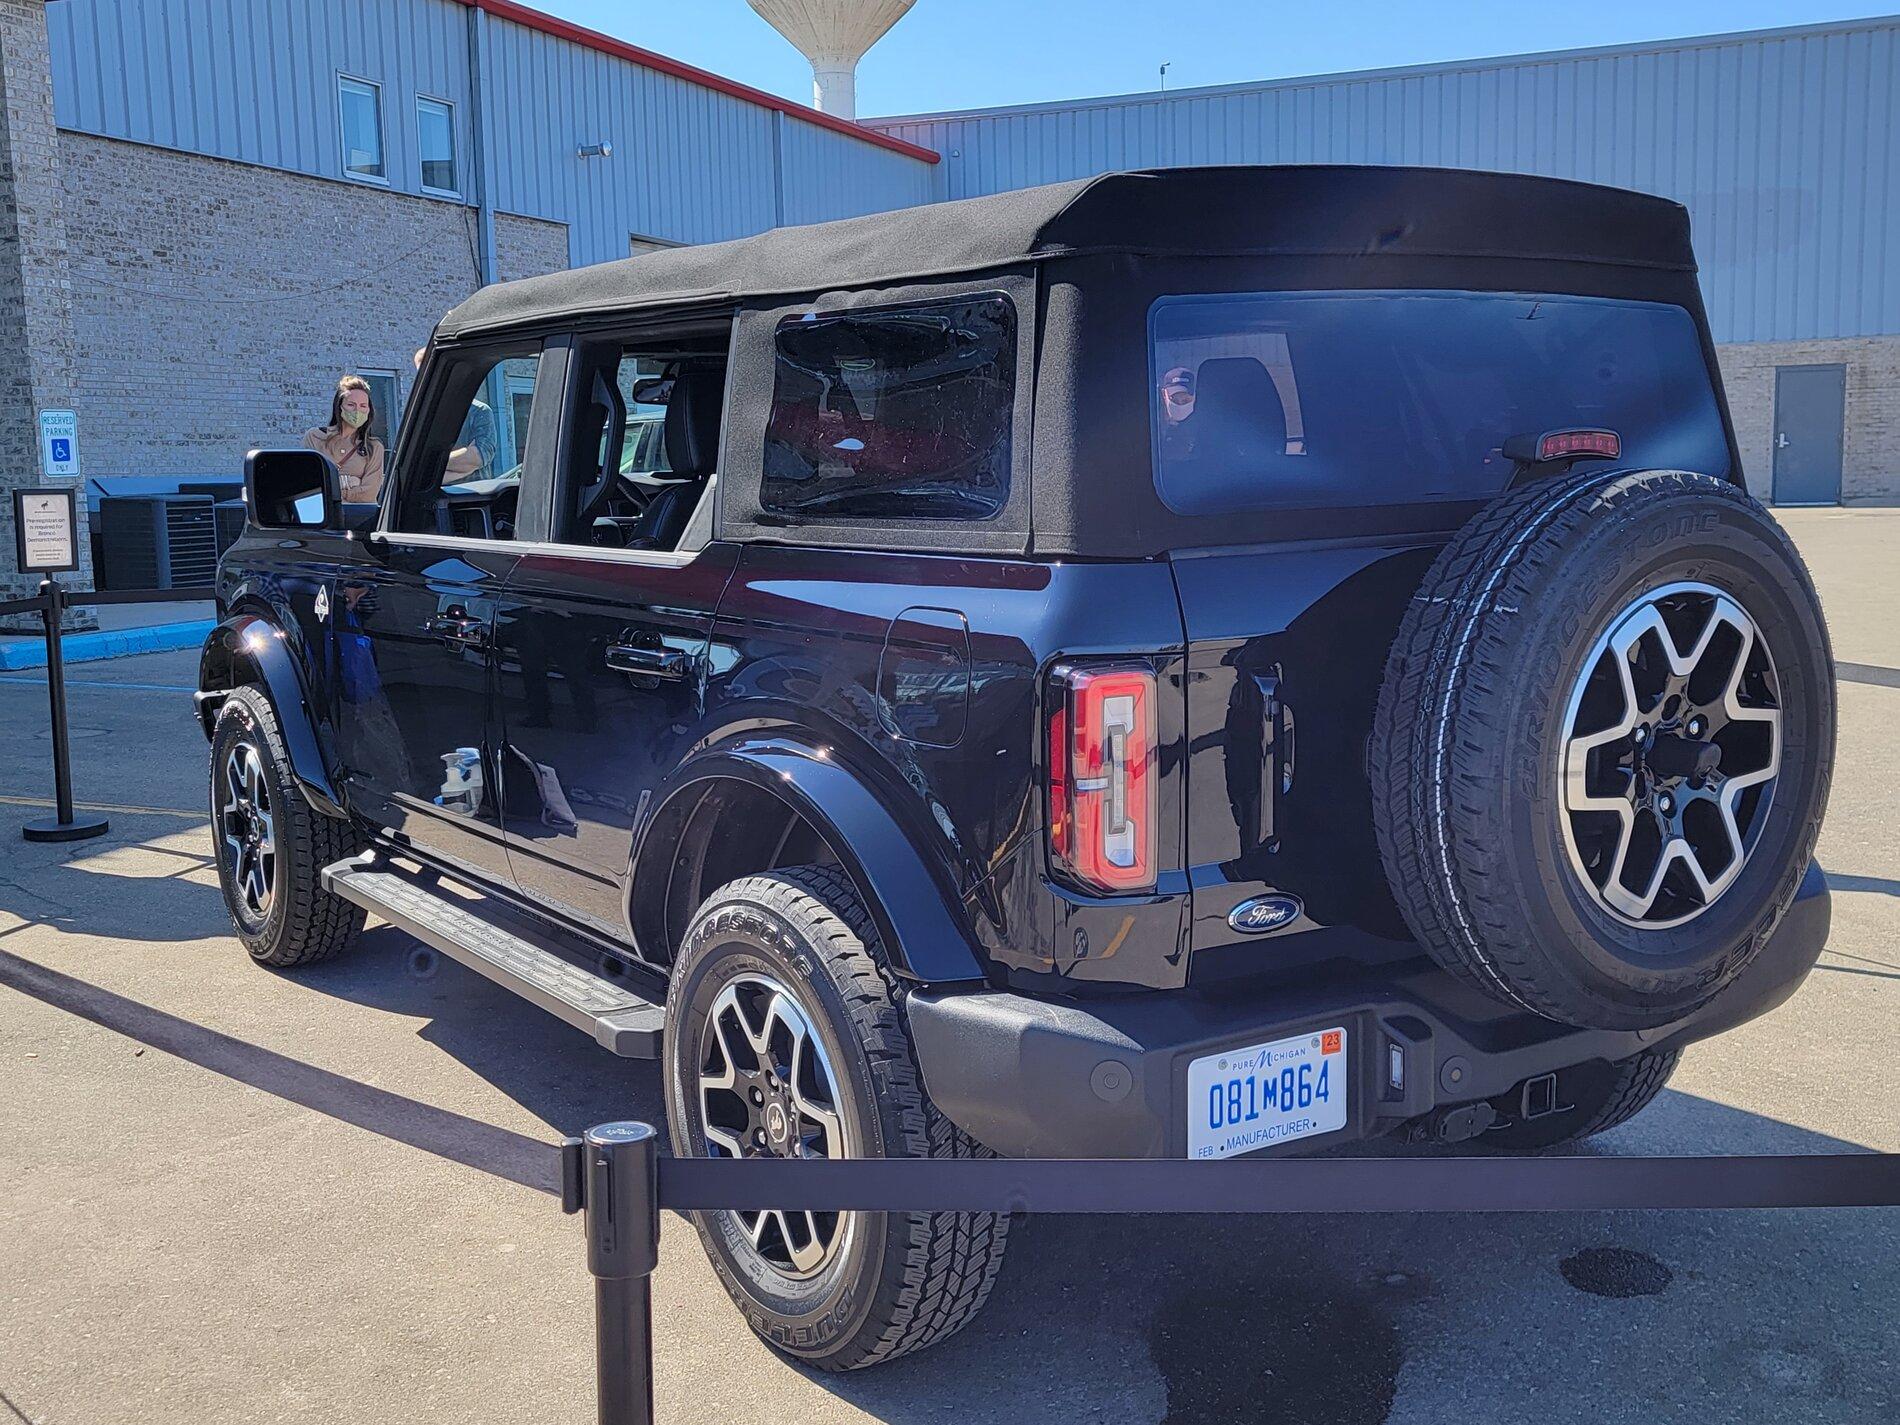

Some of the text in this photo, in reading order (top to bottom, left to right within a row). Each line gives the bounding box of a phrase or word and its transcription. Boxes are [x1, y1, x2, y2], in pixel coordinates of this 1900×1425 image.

[43, 416, 73, 425] RESERVED
[45, 427, 73, 436] PARKING
[56, 464, 69, 472] ONLY
[1247, 904, 1289, 926] Ford
[1232, 1048, 1306, 1074] PURE MICHIGAN
[1209, 1059, 1330, 1130] 081M864
[1226, 1118, 1310, 1151] MANUFACTURER
[1198, 1145, 1214, 1158] FEB
